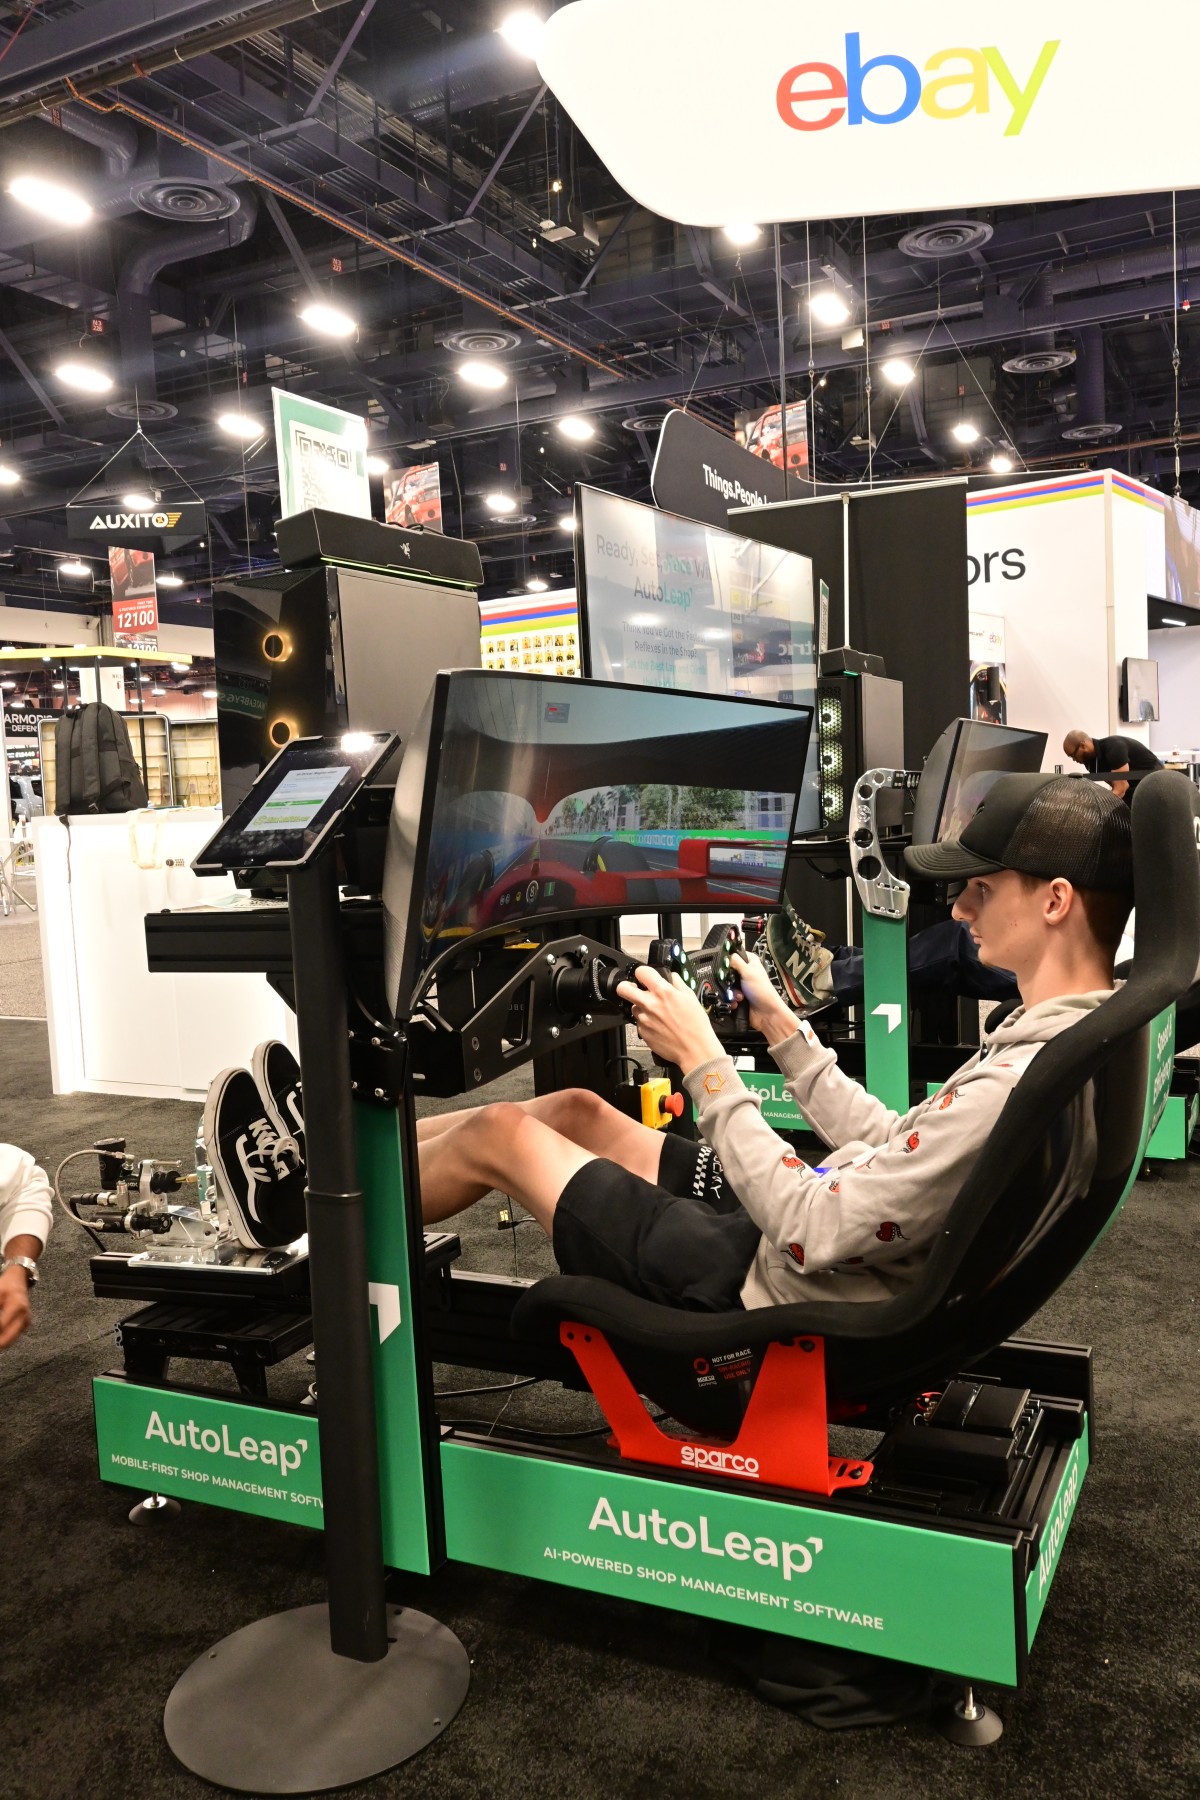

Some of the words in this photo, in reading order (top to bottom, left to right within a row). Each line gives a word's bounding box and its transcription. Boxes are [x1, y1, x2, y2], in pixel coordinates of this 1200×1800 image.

[776, 32, 1061, 136] ebay
[90, 513, 168, 529] AUXITO
[596, 534, 639, 566] Ready,
[634, 577, 693, 611] AutoLeap
[117, 610, 154, 628] 12100
[634, 641, 661, 654] Reflexes
[662, 643, 668, 655] in
[669, 645, 679, 656] the
[735, 1348, 751, 1357] RACE
[145, 1411, 307, 1477] AutoLeap
[111, 1453, 178, 1477] MOBILE-FIRST
[181, 1469, 209, 1483] SHOP
[212, 1475, 288, 1501] MANAGEMENT
[681, 1446, 759, 1477] sparco
[588, 1496, 823, 1581] AutoLeap
[1039, 1454, 1078, 1601] AutoLeap
[543, 1547, 633, 1575] AI-POWERED
[637, 1566, 677, 1584] SHOP
[681, 1576, 789, 1609] MANAGEMENT
[793, 1600, 884, 1630] SOFTWARE
